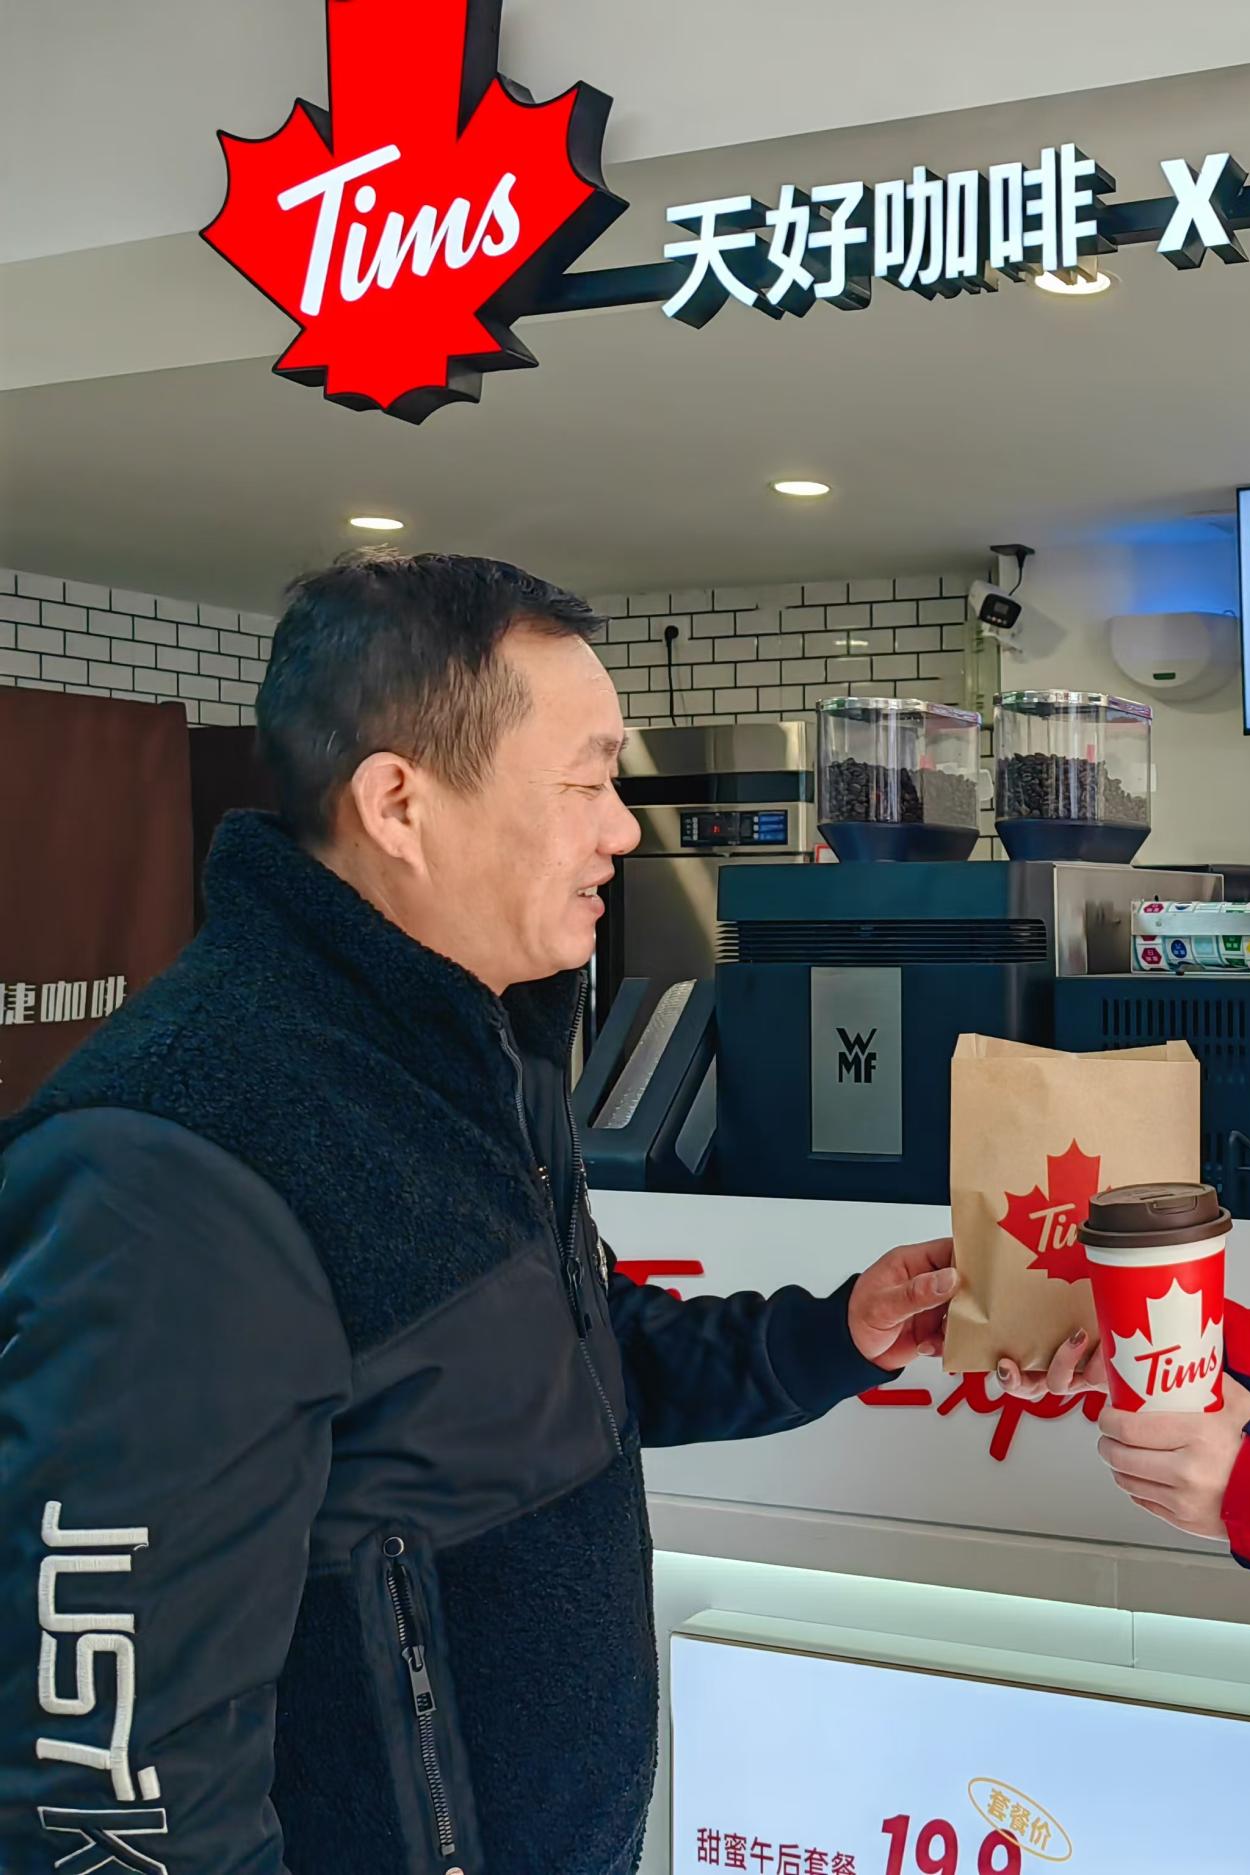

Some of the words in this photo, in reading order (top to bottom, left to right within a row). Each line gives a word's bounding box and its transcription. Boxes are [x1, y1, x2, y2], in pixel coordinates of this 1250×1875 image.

[277, 144, 519, 316] Tims
[662, 142, 1098, 318] 天好咖啡
[1029, 1203, 1078, 1253] Ti
[1135, 1345, 1218, 1396] Tims
[987, 1788, 1052, 1850] 套餐价
[696, 1827, 857, 1875] 甜蜜午后套餐
